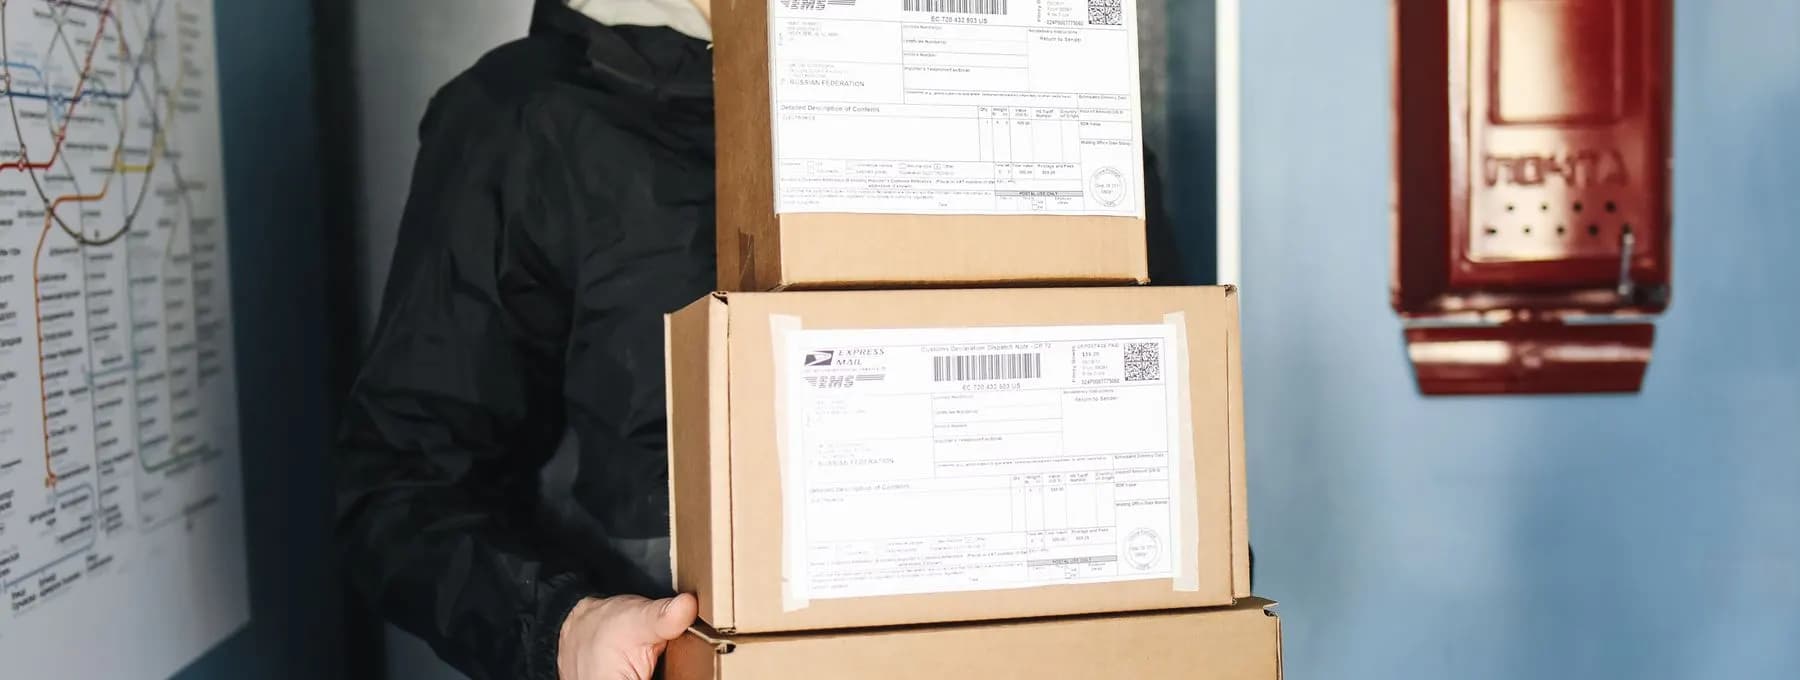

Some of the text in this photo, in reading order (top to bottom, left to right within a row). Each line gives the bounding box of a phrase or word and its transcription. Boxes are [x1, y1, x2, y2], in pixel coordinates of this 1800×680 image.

[1485, 149, 1630, 188] ПОЧТА
[838, 348, 885, 357] EXPRESS
[818, 375, 855, 389] EMS
